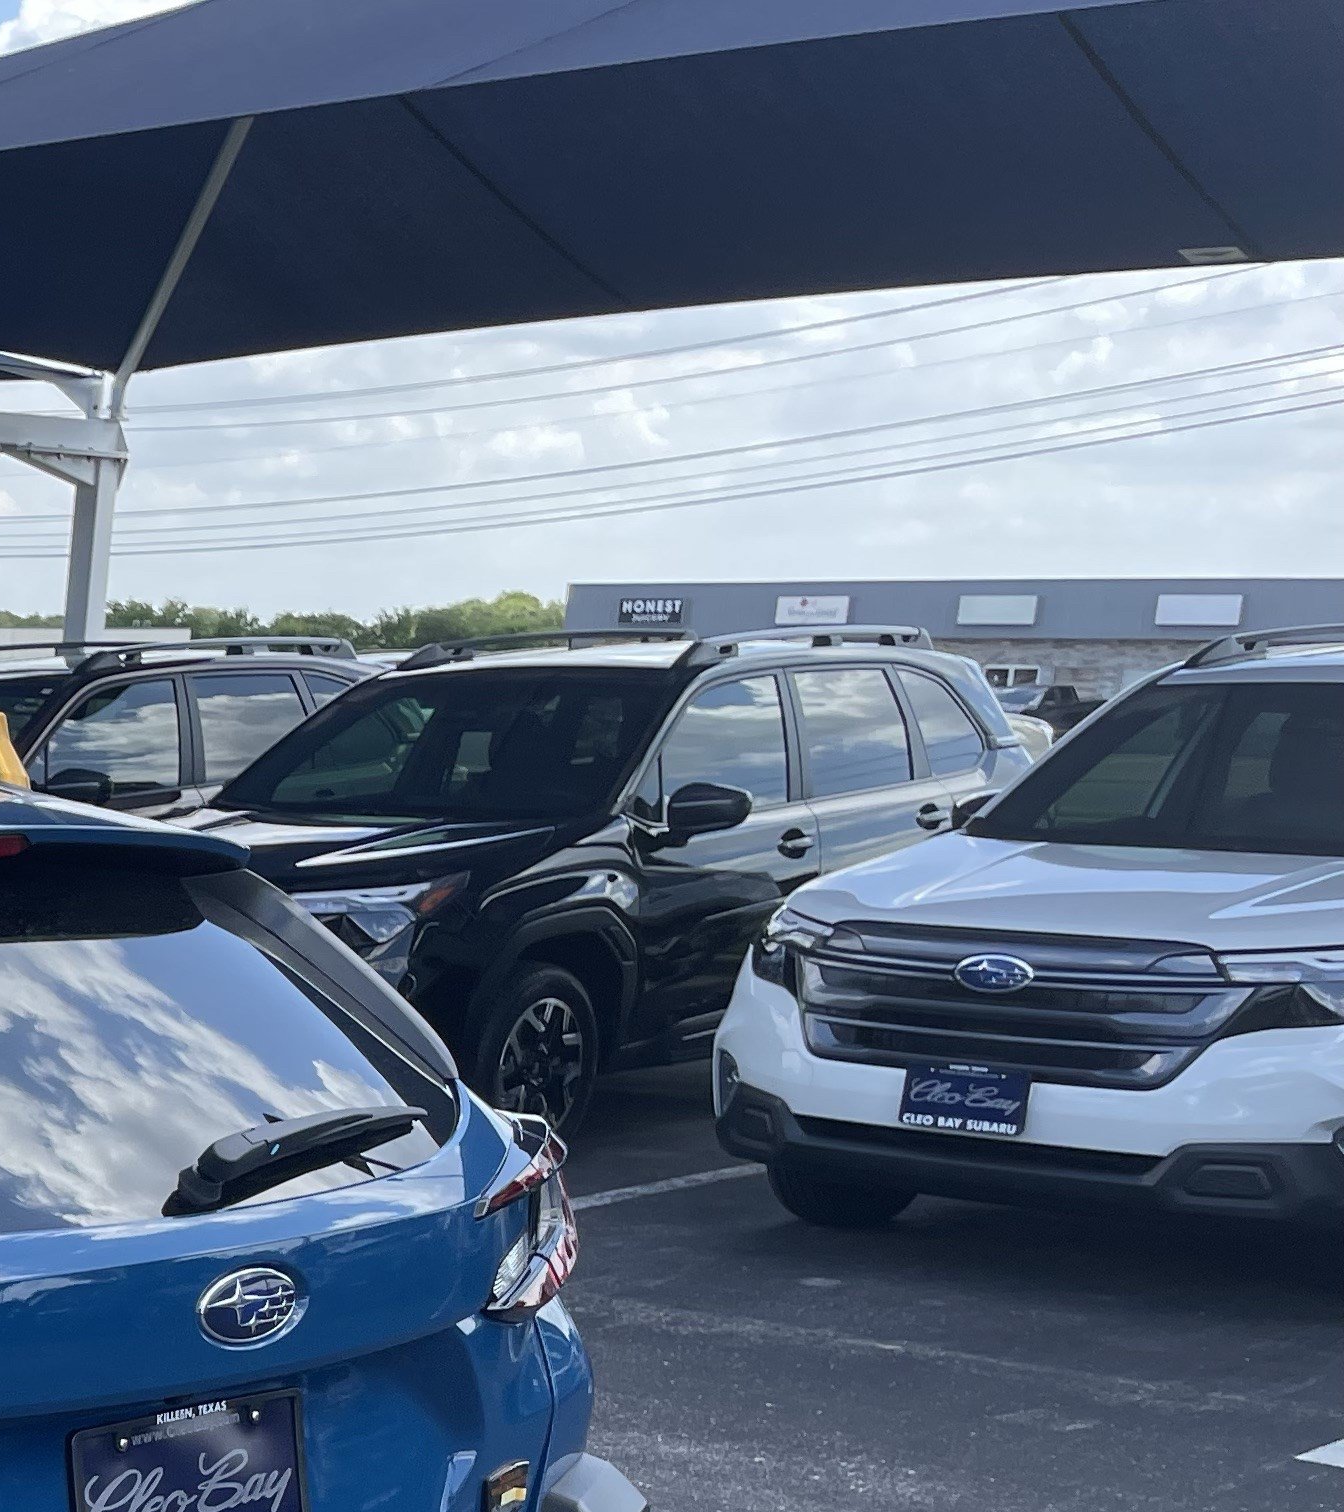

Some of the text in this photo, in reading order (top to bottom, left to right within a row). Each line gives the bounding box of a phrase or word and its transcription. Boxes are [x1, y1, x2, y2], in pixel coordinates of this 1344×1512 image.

[621, 599, 682, 614] HONEST
[910, 1077, 1021, 1117] Cleo Bay
[902, 1112, 1018, 1135] CLEO BAY SUBARU
[156, 1400, 227, 1425] KILLEEN, TEXAS
